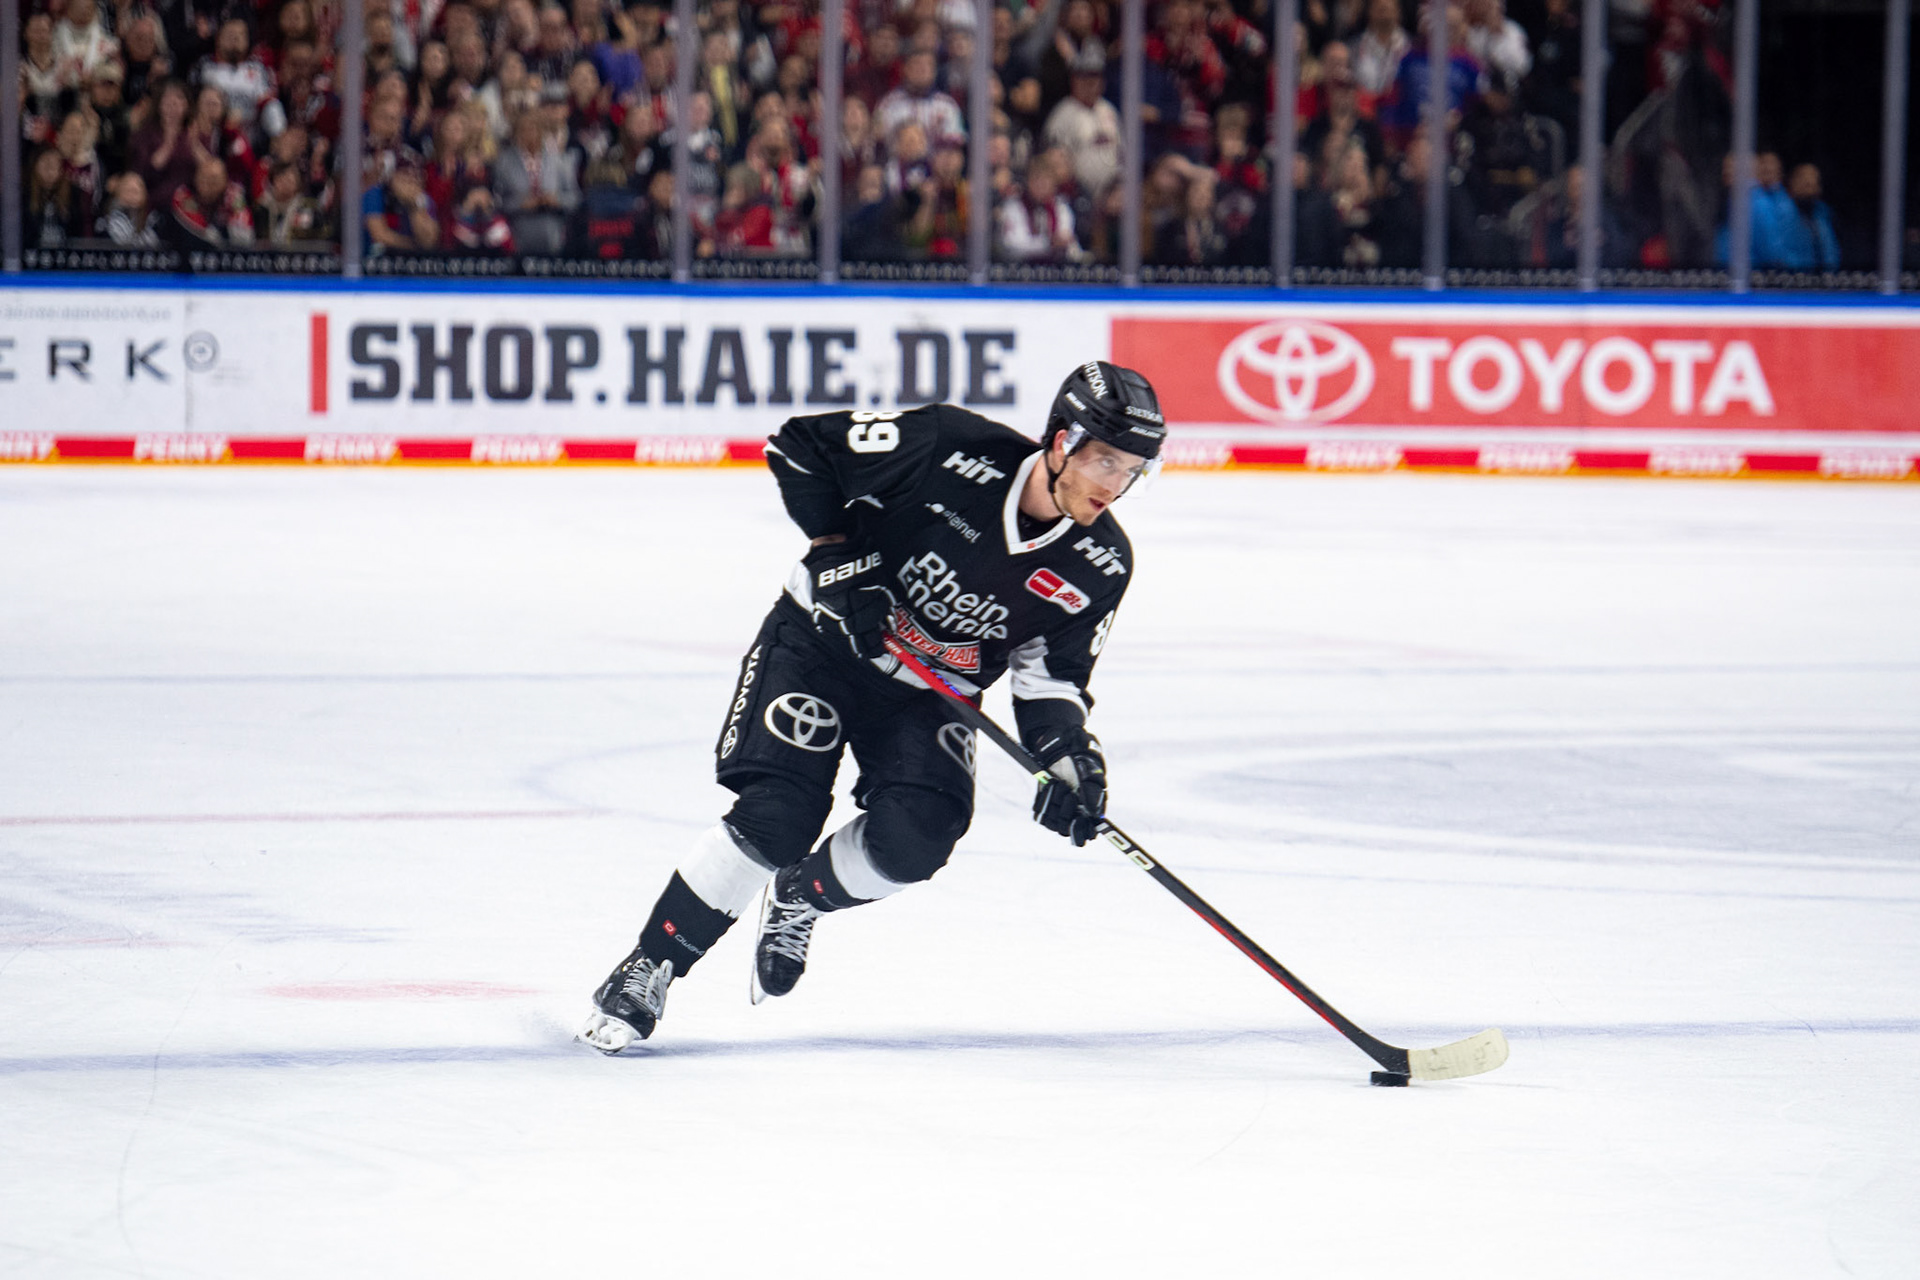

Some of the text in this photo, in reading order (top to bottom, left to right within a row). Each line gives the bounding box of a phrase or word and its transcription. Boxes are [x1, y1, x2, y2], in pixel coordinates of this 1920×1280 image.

[349, 322, 1017, 406] SHOP.HAIE.DE
[1391, 335, 1775, 416] TOYOTA
[818, 551, 882, 588] BAUE
[916, 550, 1010, 623] Rhein
[1089, 609, 1115, 657] 8
[729, 645, 763, 726] TOYOTA
